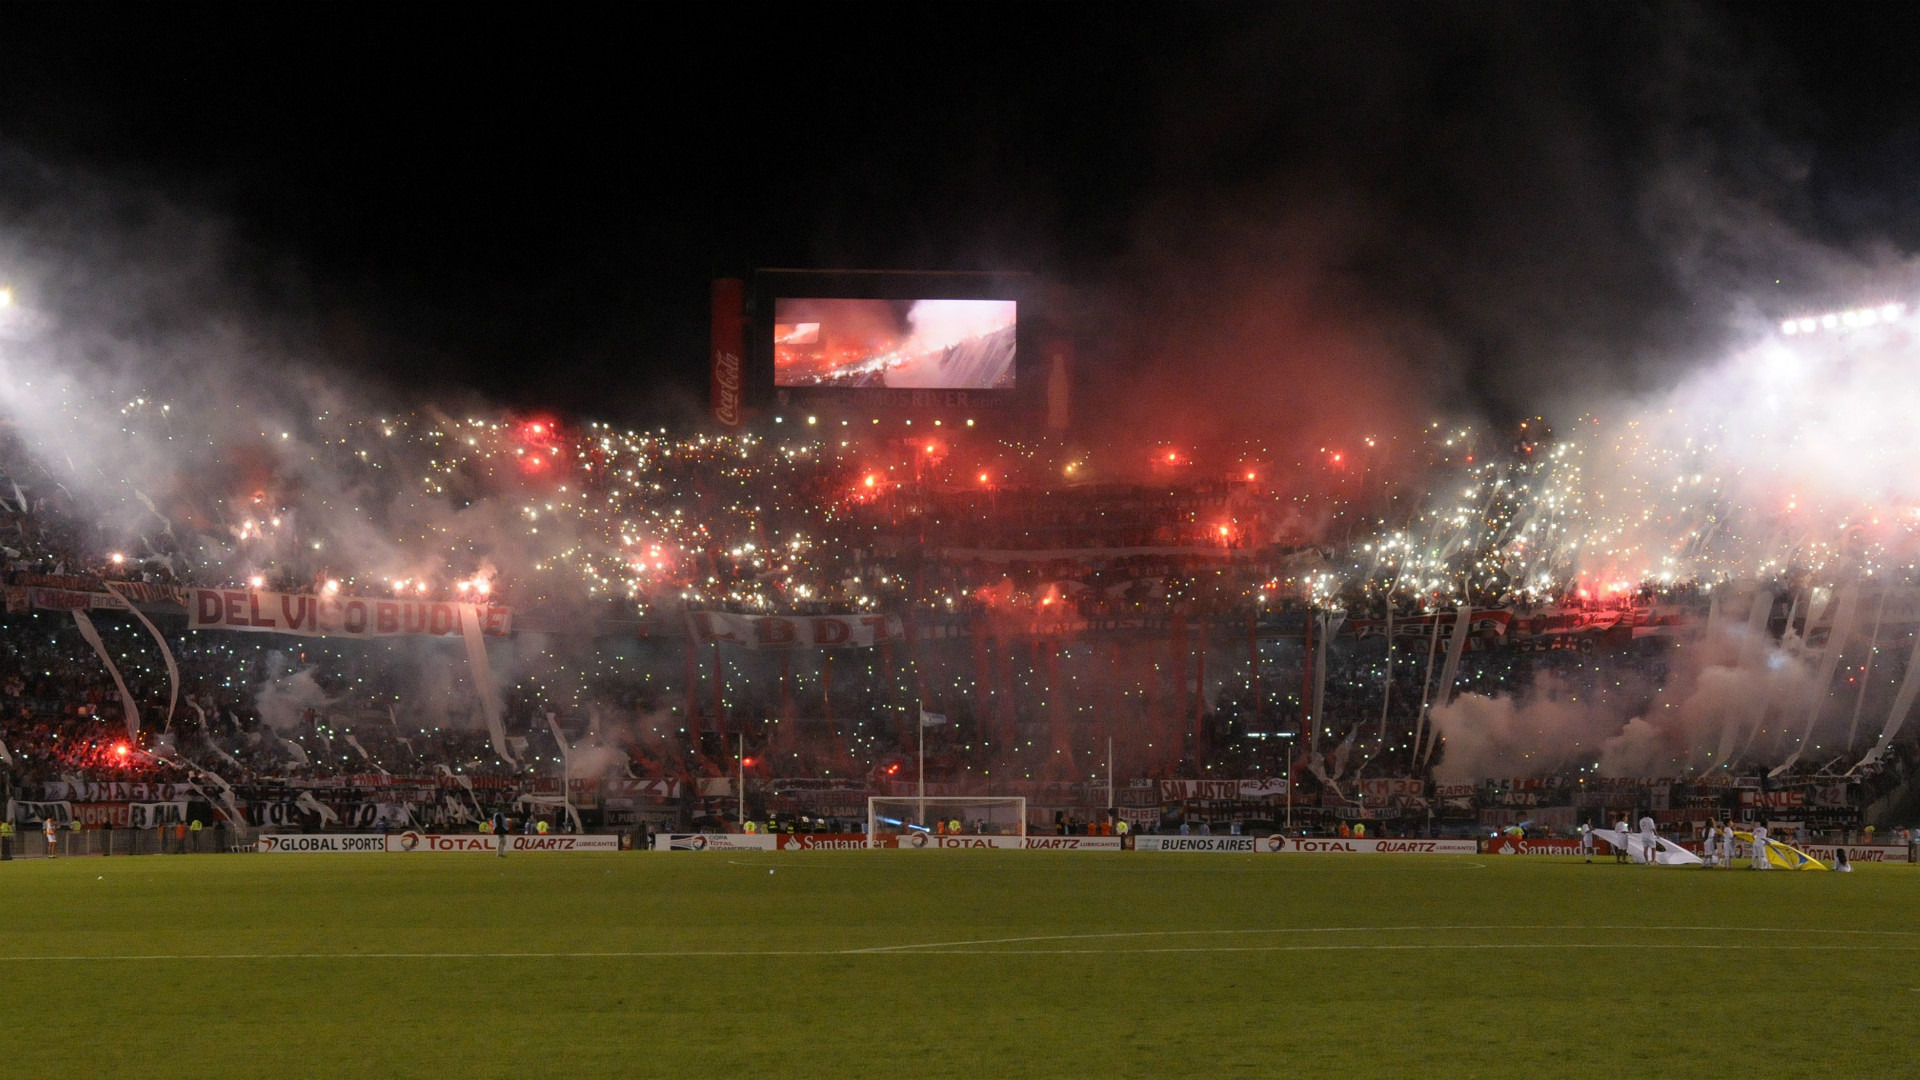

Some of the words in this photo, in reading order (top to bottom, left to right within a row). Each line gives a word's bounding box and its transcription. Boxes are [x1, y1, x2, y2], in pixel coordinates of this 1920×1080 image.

[716, 347, 739, 426] Coca-Cola
[197, 590, 276, 627] DEL
[1162, 781, 1188, 800] SAN
[1192, 781, 1235, 799] JUSTO
[1361, 780, 1390, 794] KM
[1394, 780, 1422, 793] 30
[72, 804, 128, 825] NORTE
[153, 804, 181, 824] MIA
[280, 838, 338, 850] GLOBAL
[342, 838, 384, 850] SPORTS
[425, 836, 496, 850] TOTAL
[513, 837, 576, 850] QUARTZ
[804, 836, 887, 850] Santander
[933, 836, 999, 849] TOTAL
[1018, 838, 1081, 850] QUARTZ
[1162, 839, 1215, 850] BUENOS
[1217, 839, 1253, 850] AIRES
[1291, 839, 1357, 852] TOTAL
[1376, 841, 1436, 853] QUARTZ
[1518, 841, 1600, 856] Santandr
[1849, 848, 1884, 862] QUARTZ
